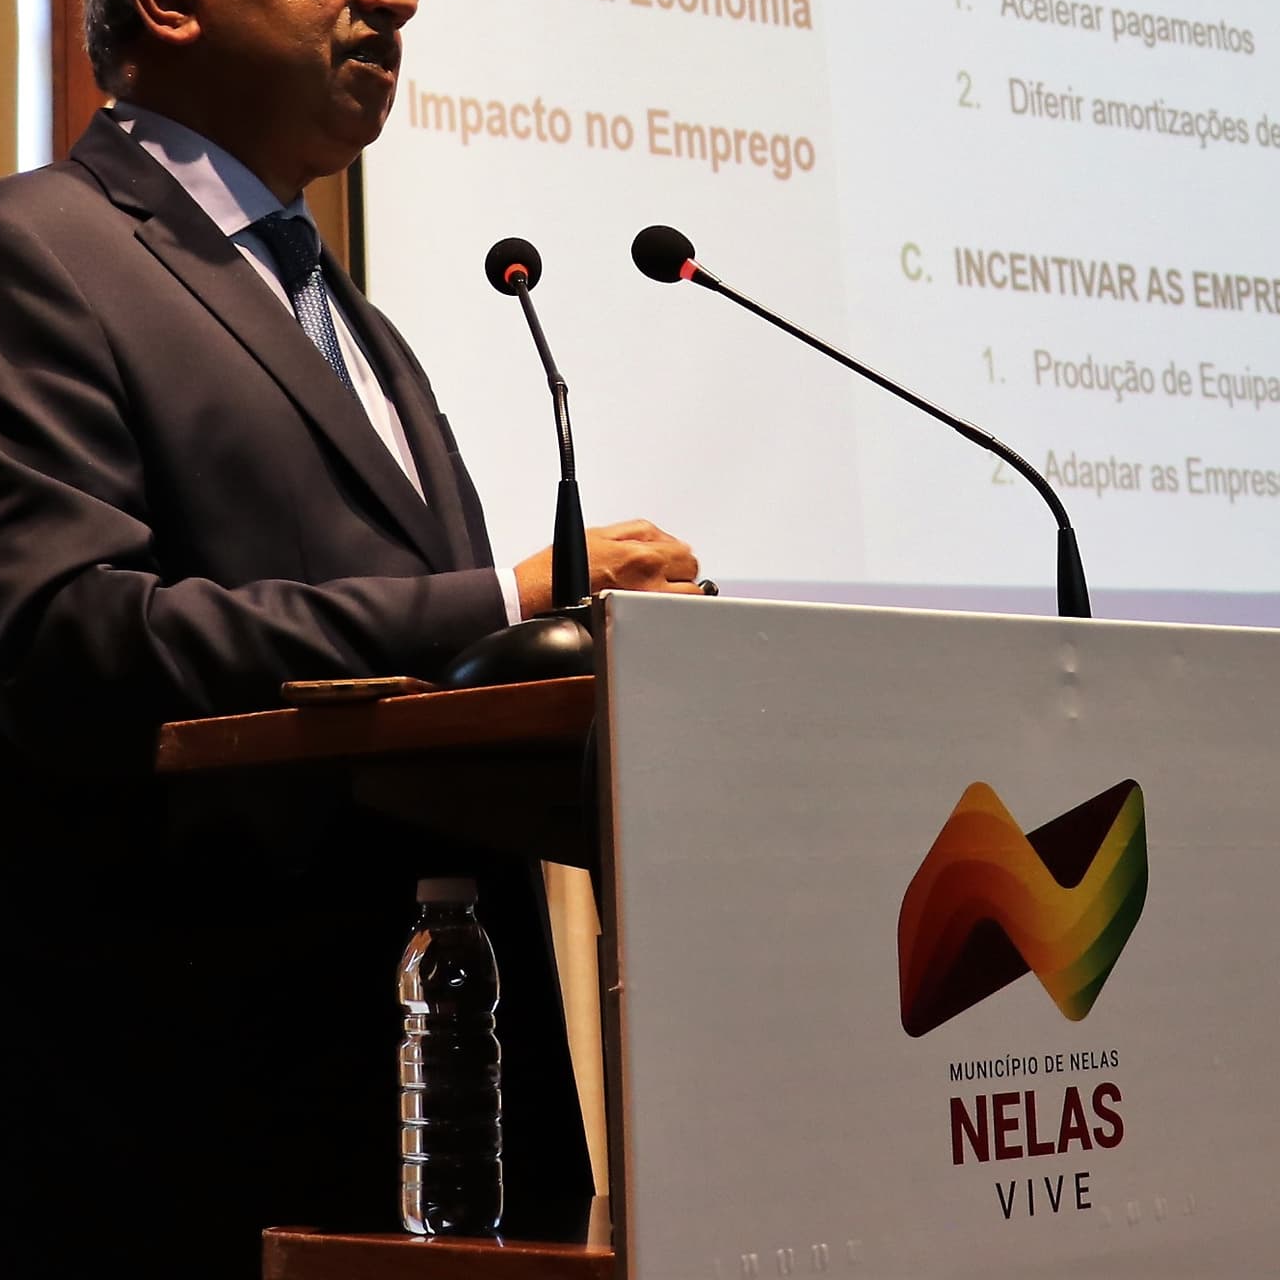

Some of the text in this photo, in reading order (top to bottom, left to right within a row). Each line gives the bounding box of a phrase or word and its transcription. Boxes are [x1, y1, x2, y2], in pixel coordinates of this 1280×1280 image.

[1111, 7, 1255, 55] pagamentos
[408, 79, 816, 181] Impacto no Emprego
[957, 69, 981, 109] 2.
[1009, 77, 1084, 122] Diferir
[1092, 97, 1250, 149] amortizações
[900, 242, 933, 283] C.
[955, 245, 1138, 302] INCENTIVAR
[1146, 267, 1185, 306] AS
[982, 347, 1006, 384] 1.
[1034, 348, 1155, 401] Produção
[1162, 359, 1193, 396] de
[1045, 449, 1144, 497] Adaptar
[1151, 464, 1179, 492] as
[950, 1050, 1119, 1082] MUNICÍPIO DE NELAS
[950, 1082, 1124, 1166] NELAS
[996, 1172, 1092, 1220] VIVE
